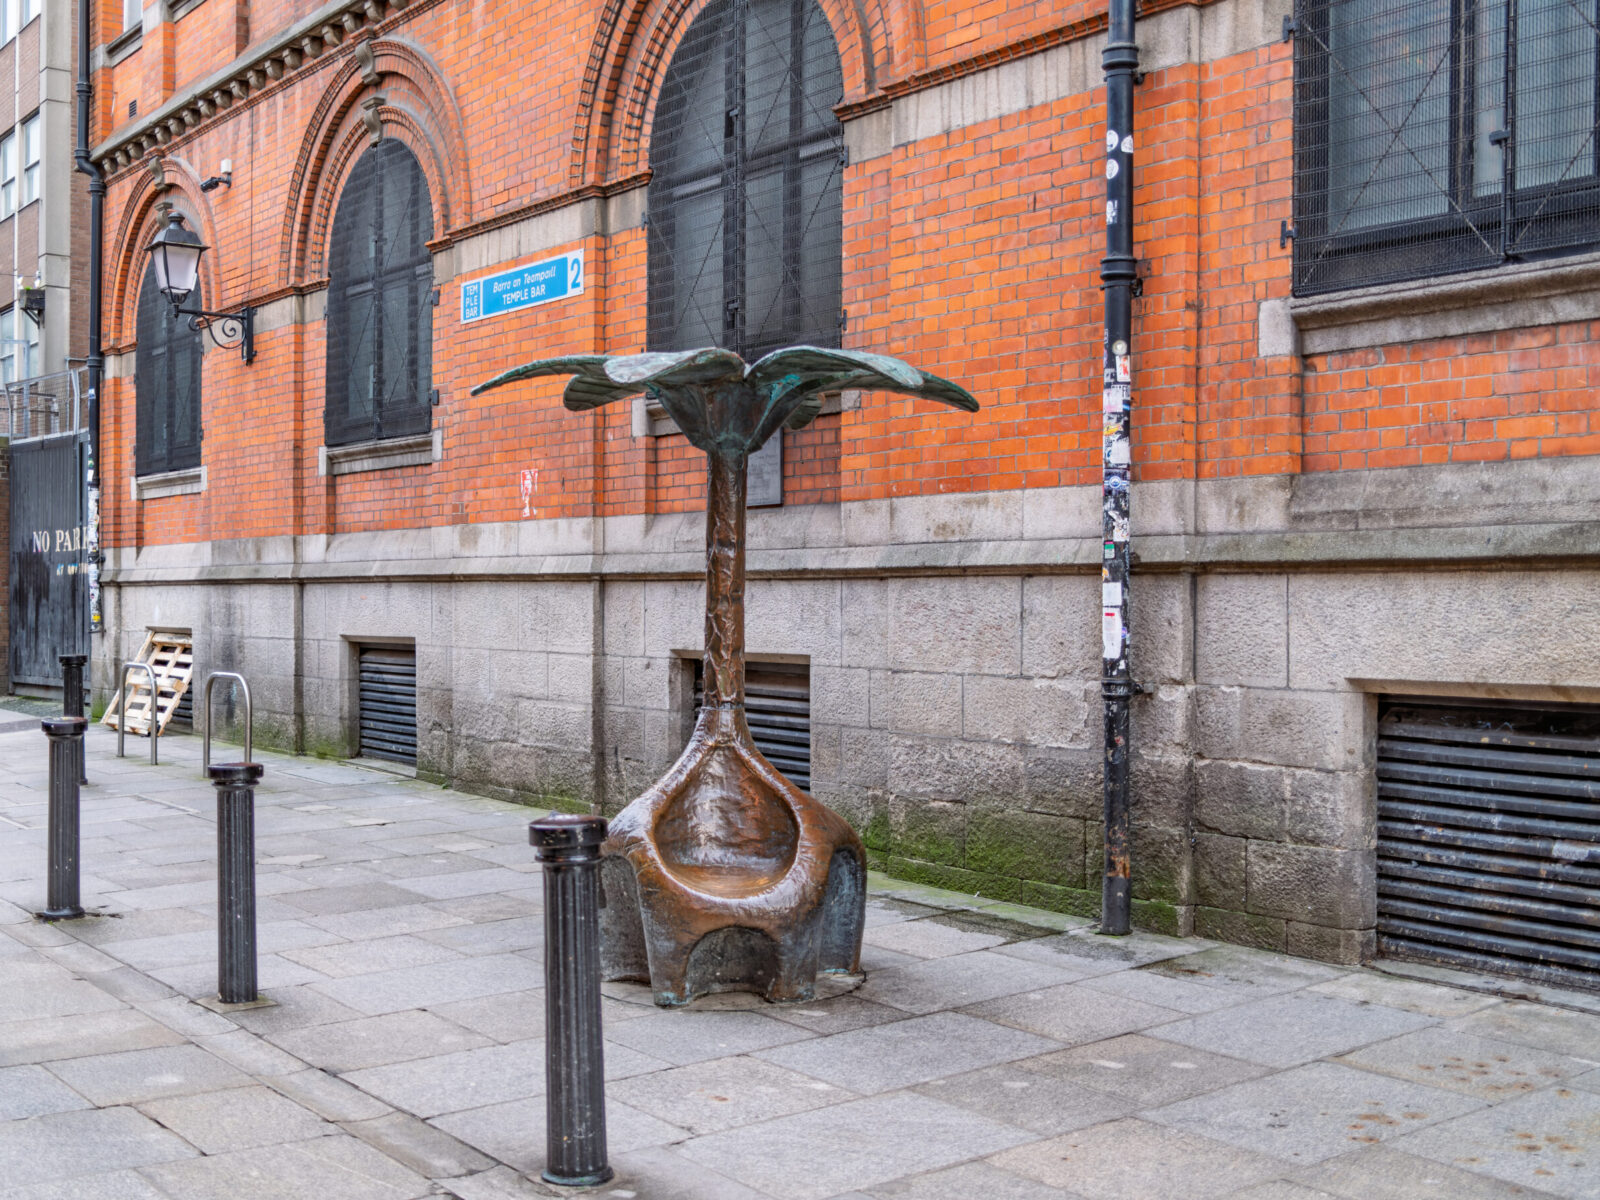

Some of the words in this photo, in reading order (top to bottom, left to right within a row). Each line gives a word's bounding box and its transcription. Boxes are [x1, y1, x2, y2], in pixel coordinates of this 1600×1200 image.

[493, 281, 511, 294] Barra
[512, 278, 521, 288] an
[524, 266, 556, 283] Teampaill
[570, 258, 581, 289] 2
[466, 284, 478, 296] TEM
[502, 287, 529, 305] TEMPLE
[530, 284, 546, 298] BAR
[465, 295, 478, 308] PLE
[465, 306, 478, 319] BAR
[32, 530, 50, 552] NO
